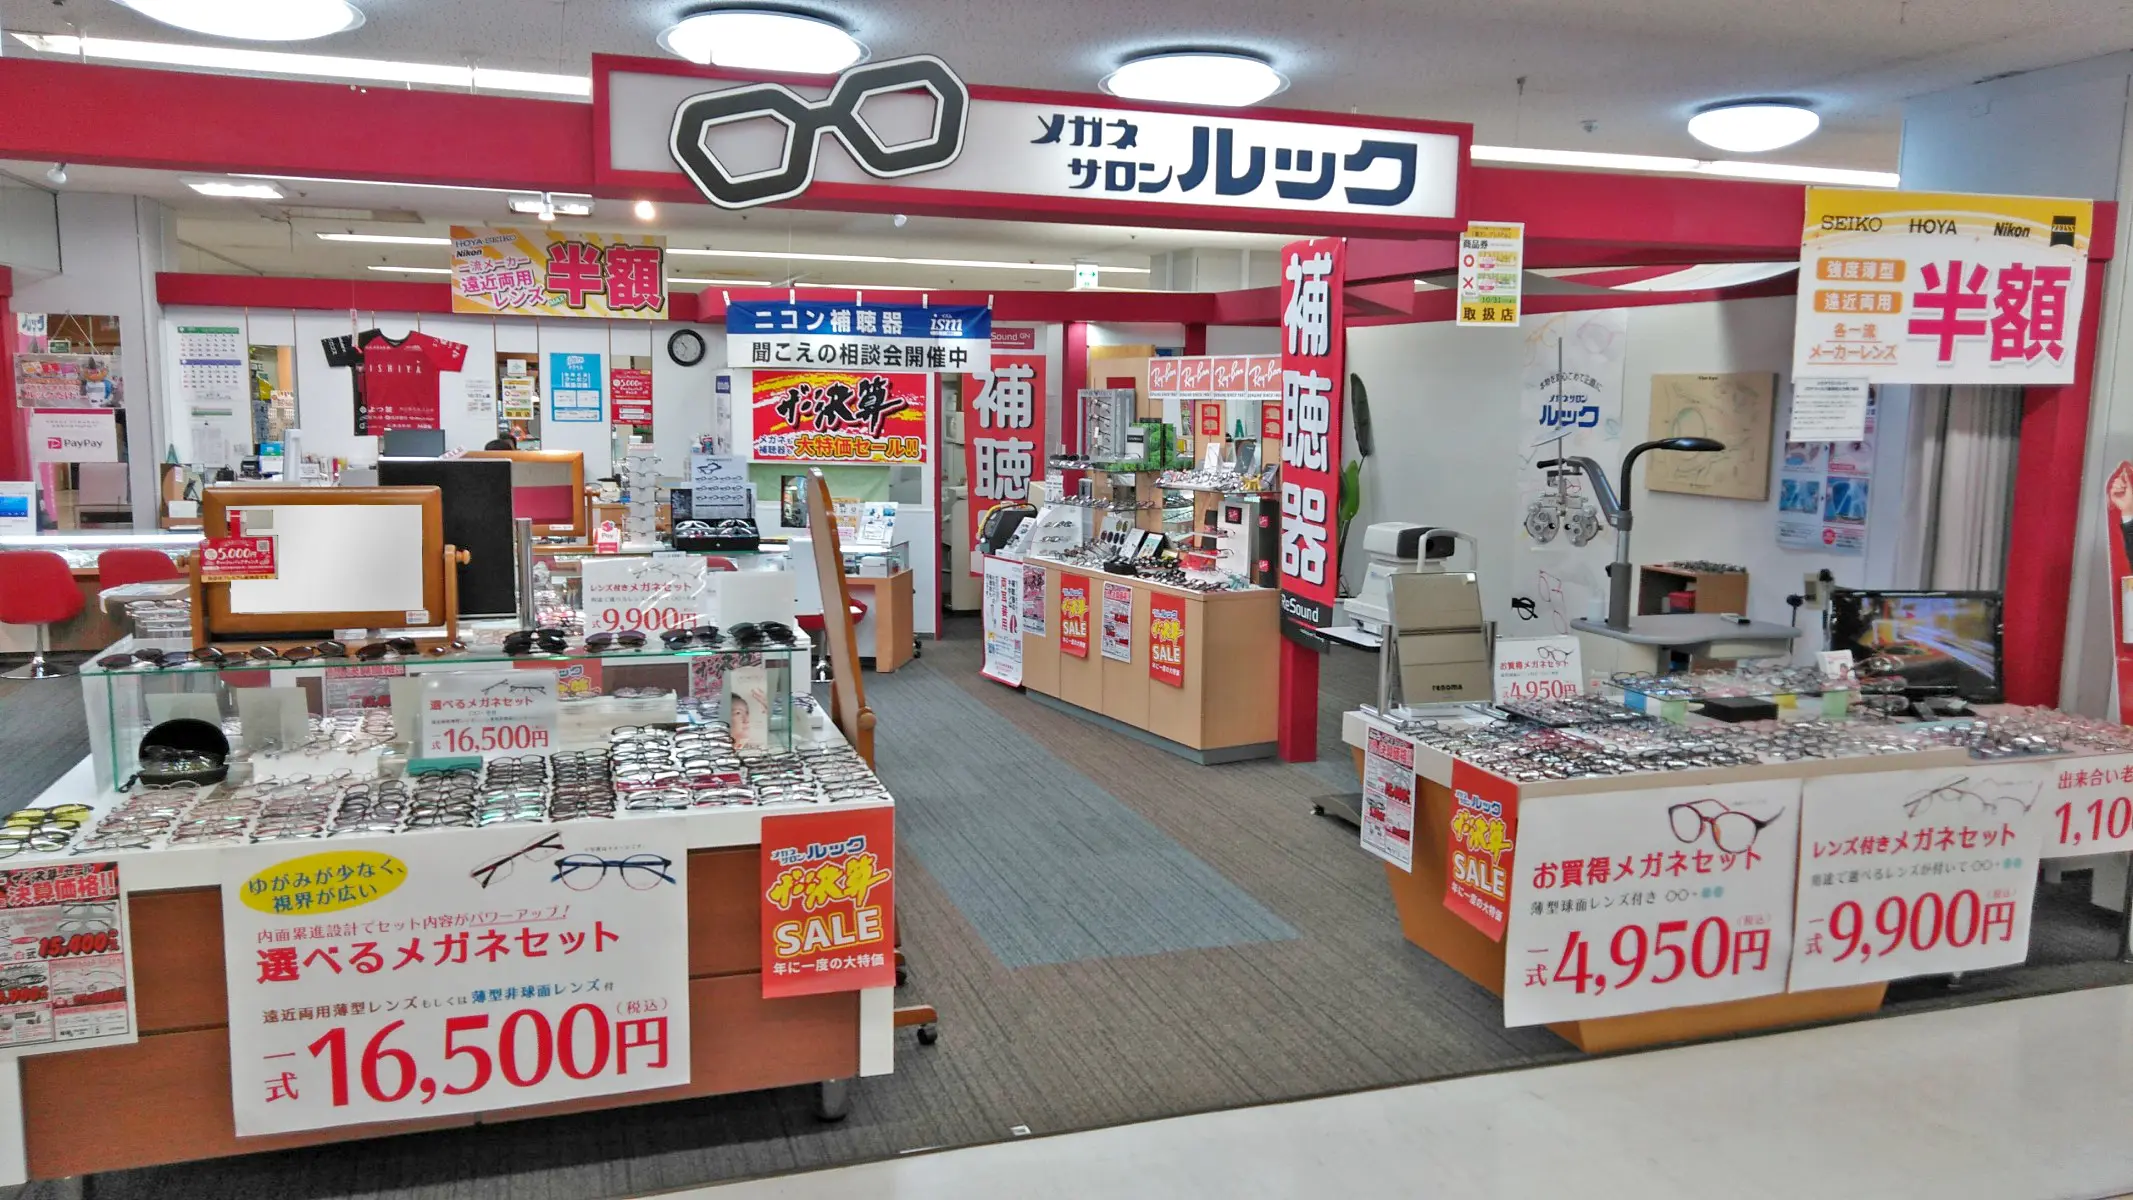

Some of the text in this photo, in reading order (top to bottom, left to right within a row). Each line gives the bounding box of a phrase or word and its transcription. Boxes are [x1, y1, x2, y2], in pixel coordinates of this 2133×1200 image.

[1030, 113, 1138, 150] メガネ
[1067, 157, 1173, 194] サロン
[1177, 125, 1418, 207] ルック
[1821, 215, 1883, 233] SEIKO
[1909, 218, 1957, 235] HOYA
[1993, 221, 2031, 238] Nikon
[455, 234, 517, 248] HOYA SEIKO
[456, 249, 483, 257] Nikon
[1463, 239, 1489, 250] 商品券
[459, 256, 530, 272] 一流メーカー
[546, 241, 666, 312] 半額
[1826, 259, 1897, 281] 強度薄型
[462, 269, 533, 294] 遠近両用
[493, 286, 546, 307] レンズ
[1823, 290, 1893, 312] 遠近両用
[754, 310, 903, 335] ニコン補聴器
[930, 313, 963, 331] ism
[1463, 307, 1515, 322] 取扱店
[1907, 259, 2072, 363] 半額
[1833, 322, 1878, 340] 各一流
[752, 342, 968, 369] 聞こえの相談会開催中
[1808, 343, 1898, 361] メーカーレンズ
[1282, 252, 1333, 586] 補聴器
[1539, 405, 1600, 428] ルック
[64, 438, 103, 449] PayPay
[590, 582, 692, 593] レンズ付きメガネセット
[1063, 620, 1087, 637] SALE
[1152, 644, 1181, 663] SALE
[1510, 679, 1577, 700] 4950円
[430, 696, 533, 711] 選べるメガネセット
[443, 724, 549, 753] 16,500円
[2055, 797, 2133, 847] 1,10
[806, 836, 866, 860] ルック
[1812, 823, 2016, 859] レンズ付きメガネセット
[248, 857, 403, 896] ゆがみが少なく、
[1453, 852, 1506, 899] SALE
[1531, 844, 1762, 891] お買得メガネセット
[272, 882, 379, 914] 視界が広い
[1530, 891, 1658, 916] 薄型球面レンズ付き
[776, 909, 882, 957] SALE
[1805, 917, 1825, 956] 一式
[1828, 888, 2016, 965] 9,900円
[255, 920, 620, 985] 選べるメガネセット
[773, 952, 885, 976] 年に一度の大特価
[1552, 915, 1771, 997] 4,950円
[1524, 947, 1549, 987] 一式
[307, 1002, 669, 1107] 16,500円
[262, 1050, 300, 1104] 一式
